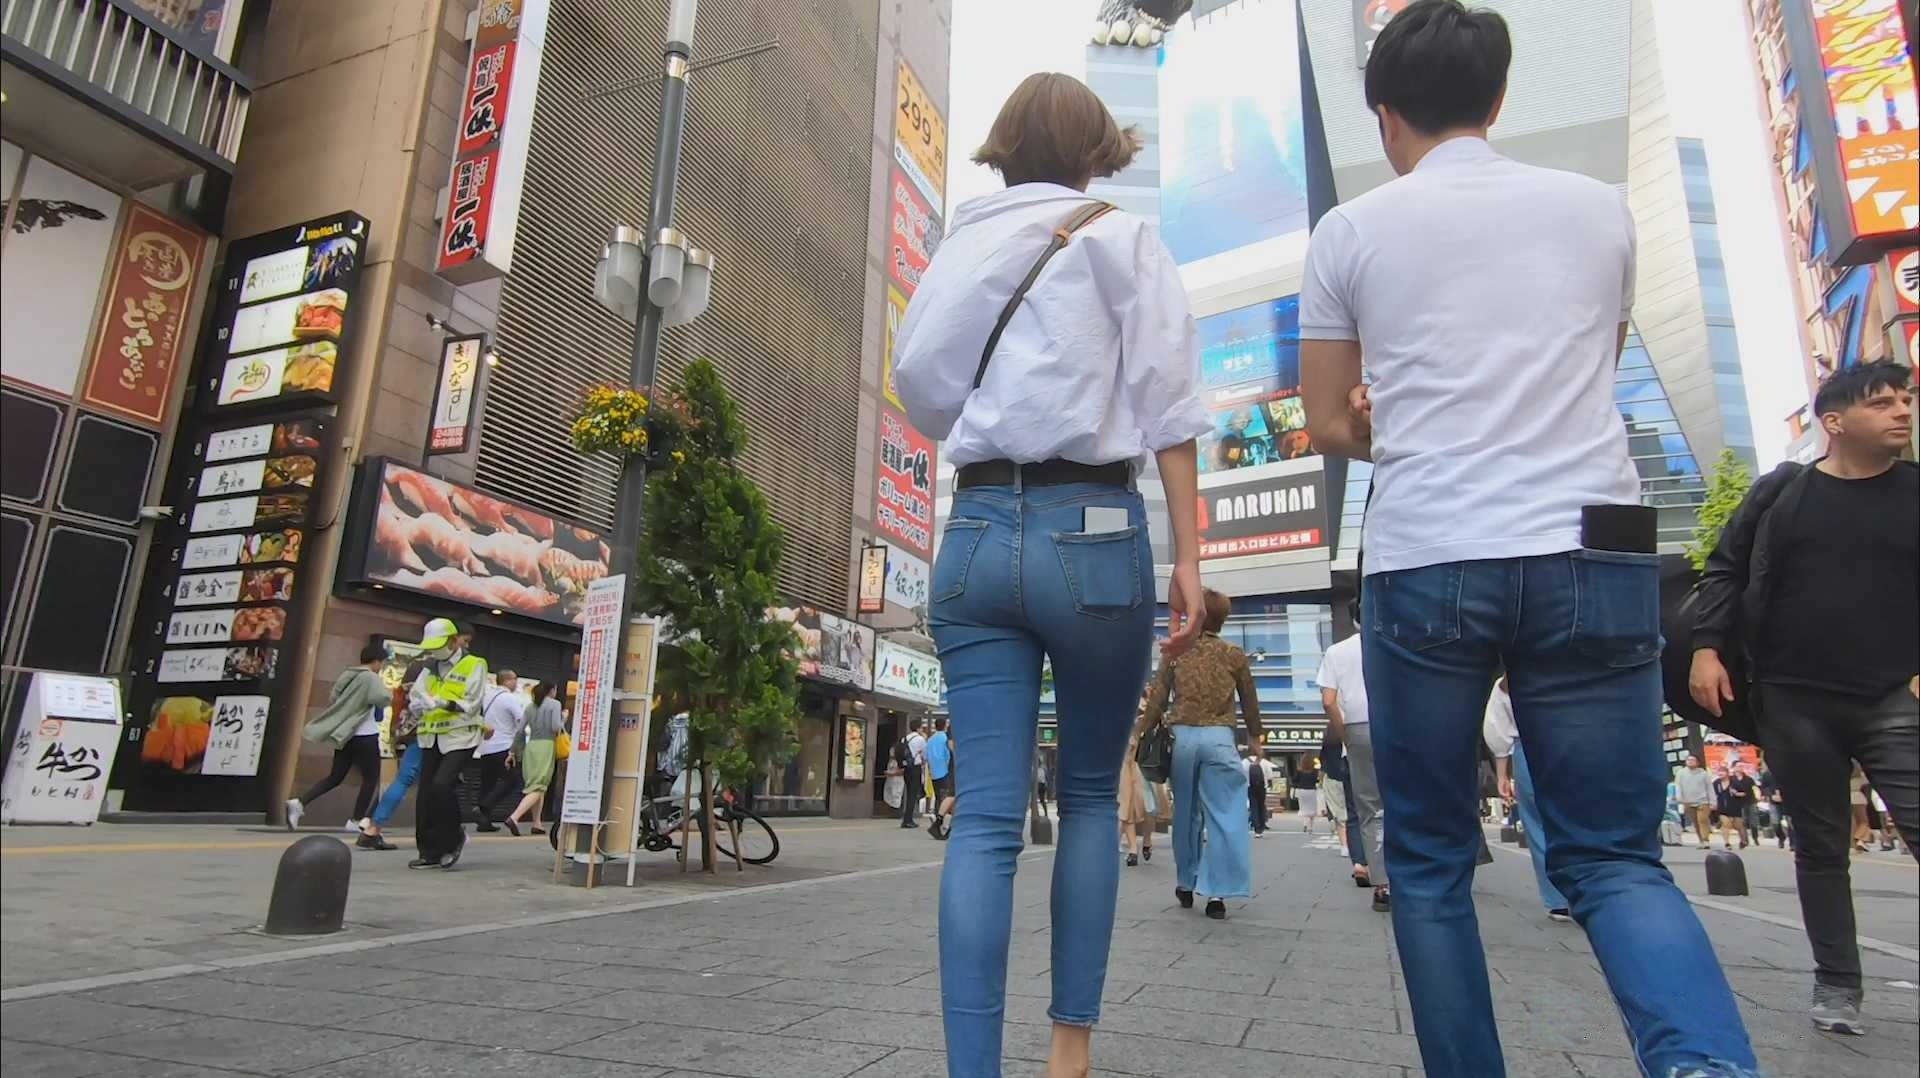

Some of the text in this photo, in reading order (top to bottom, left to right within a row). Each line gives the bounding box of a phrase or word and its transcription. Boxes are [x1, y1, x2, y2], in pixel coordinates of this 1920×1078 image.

[899, 84, 932, 145] 299
[217, 327, 229, 341] 10
[187, 477, 195, 489] 7
[1216, 485, 1316, 522] MARUHAN
[179, 513, 186, 525] 6
[170, 548, 179, 561] 5
[163, 585, 171, 597] 4
[154, 622, 163, 635] 3
[145, 660, 155, 673] 2
[1267, 730, 1324, 739] ACORN
[36, 741, 102, 781] 牛かつ
